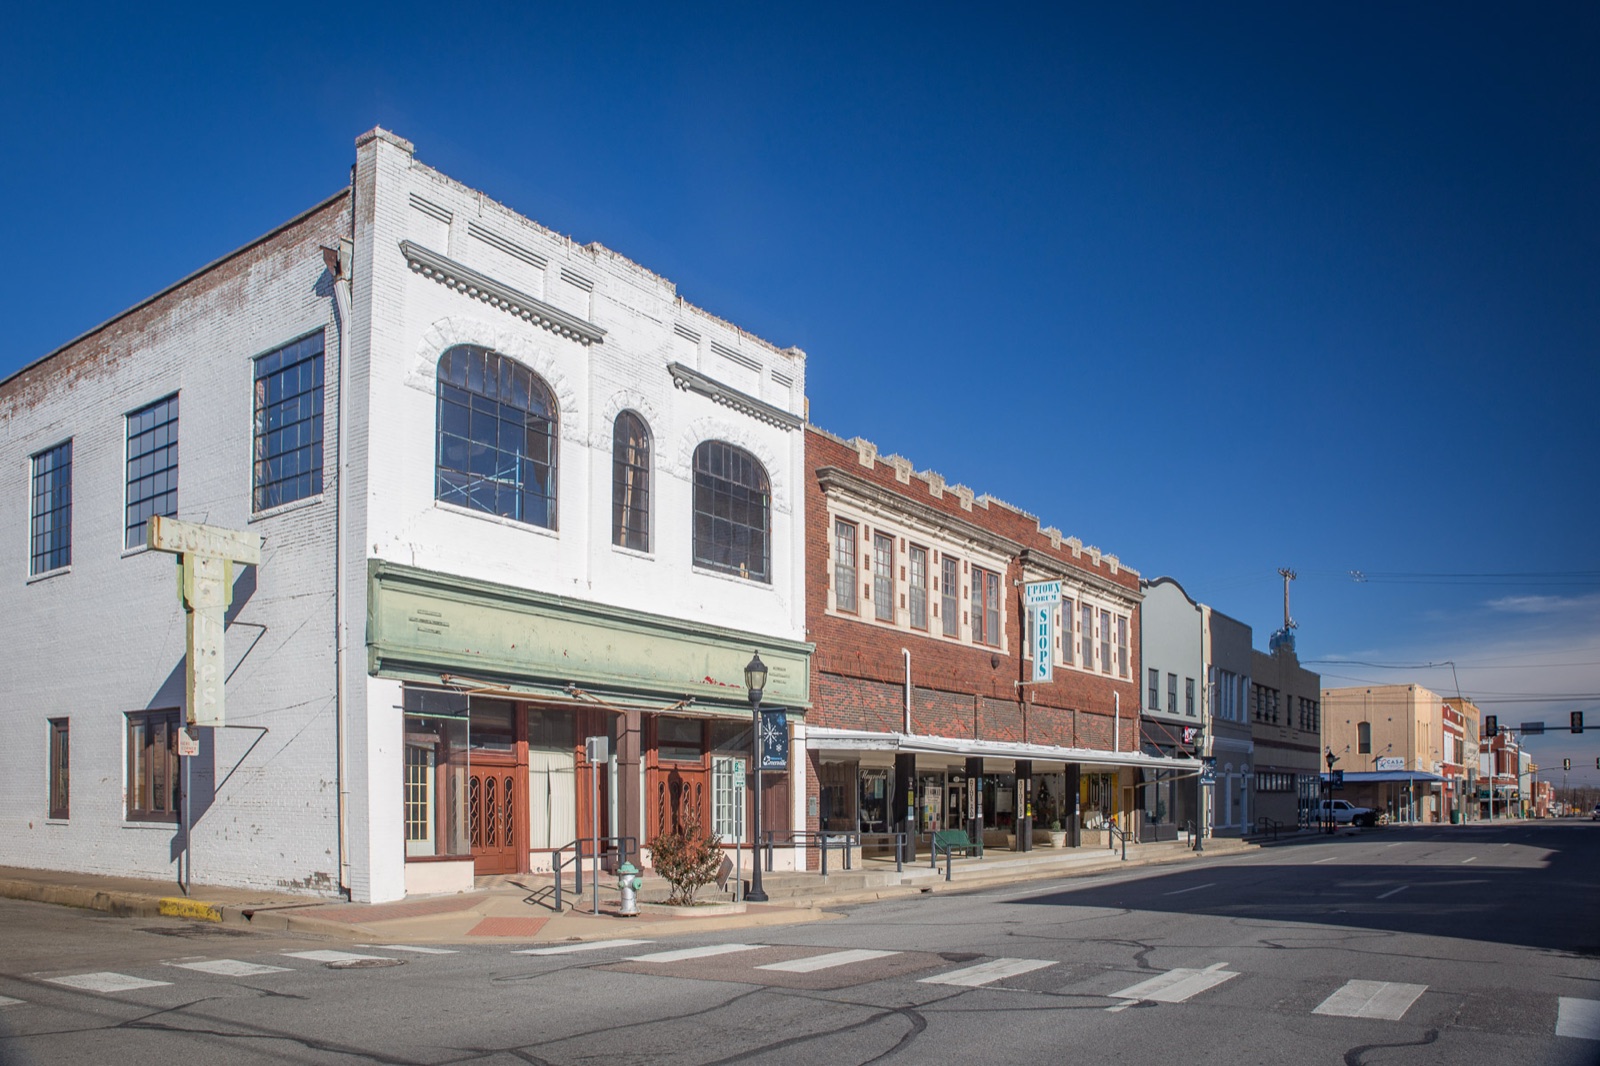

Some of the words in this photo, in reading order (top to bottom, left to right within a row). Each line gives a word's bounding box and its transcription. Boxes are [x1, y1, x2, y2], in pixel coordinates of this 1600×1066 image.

[1027, 582, 1060, 596] UPTOWN
[1031, 594, 1056, 602] FORUM
[1039, 609, 1048, 677] SHOPS
